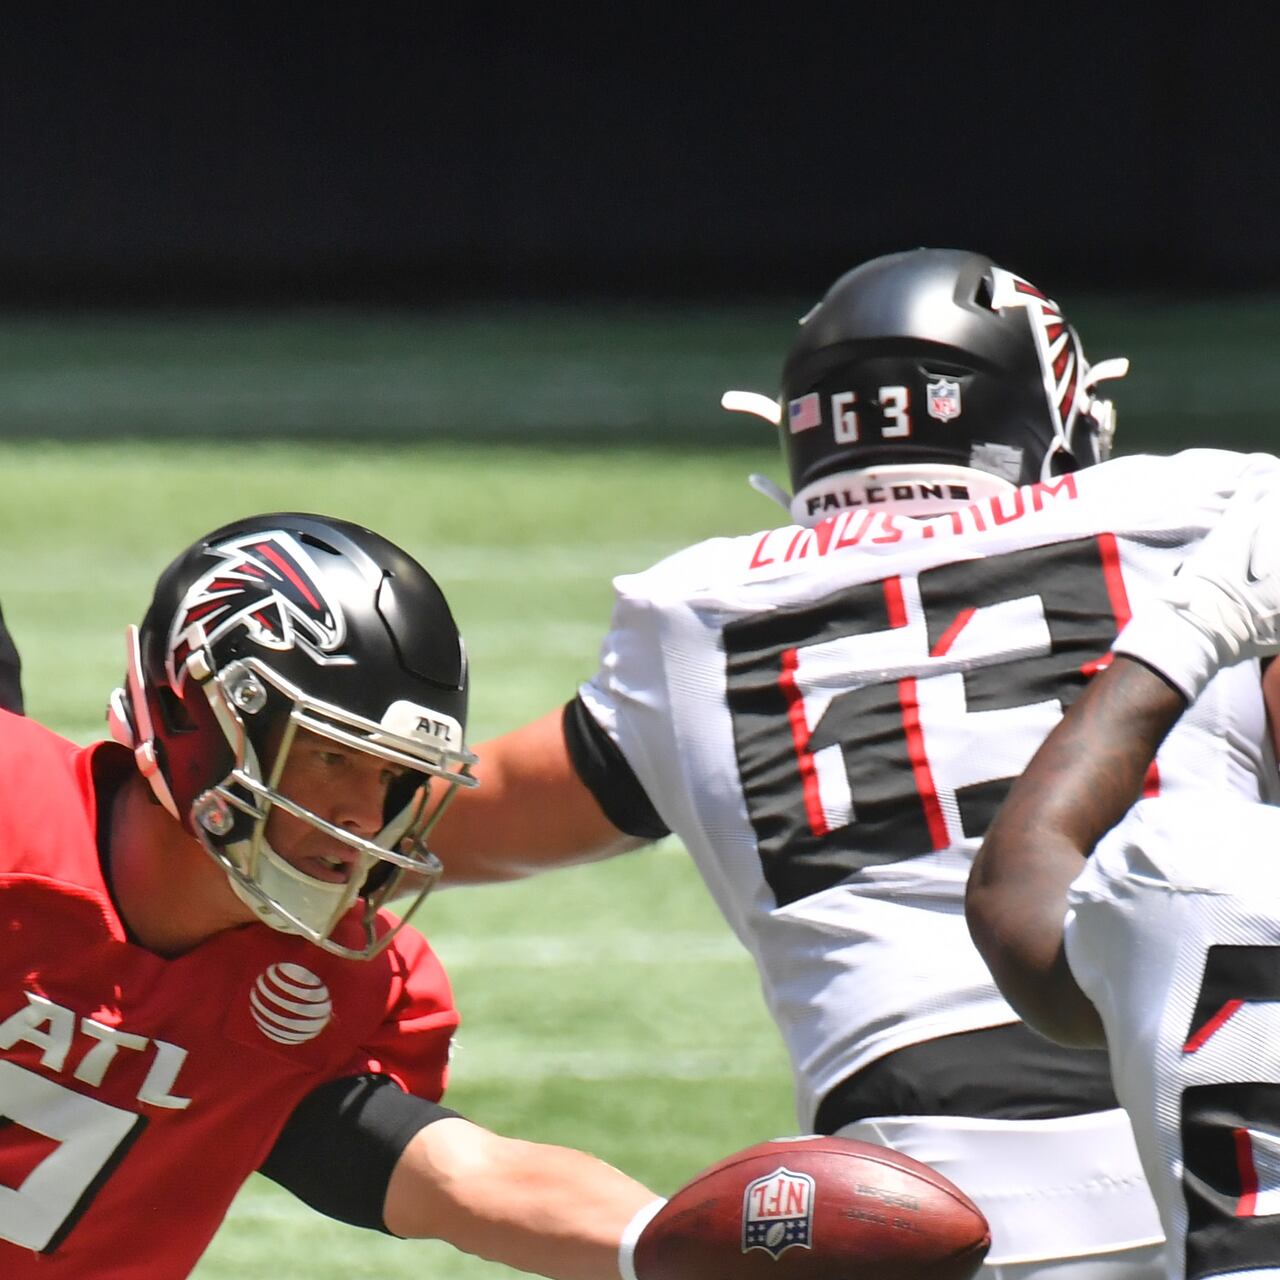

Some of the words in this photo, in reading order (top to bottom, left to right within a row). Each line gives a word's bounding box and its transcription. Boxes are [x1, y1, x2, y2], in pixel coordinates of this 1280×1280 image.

[831, 386, 911, 444] 63
[806, 484, 970, 516] FALCONS
[415, 715, 451, 741] ATL
[723, 532, 1160, 908] 63
[752, 1179, 805, 1217] NFL
